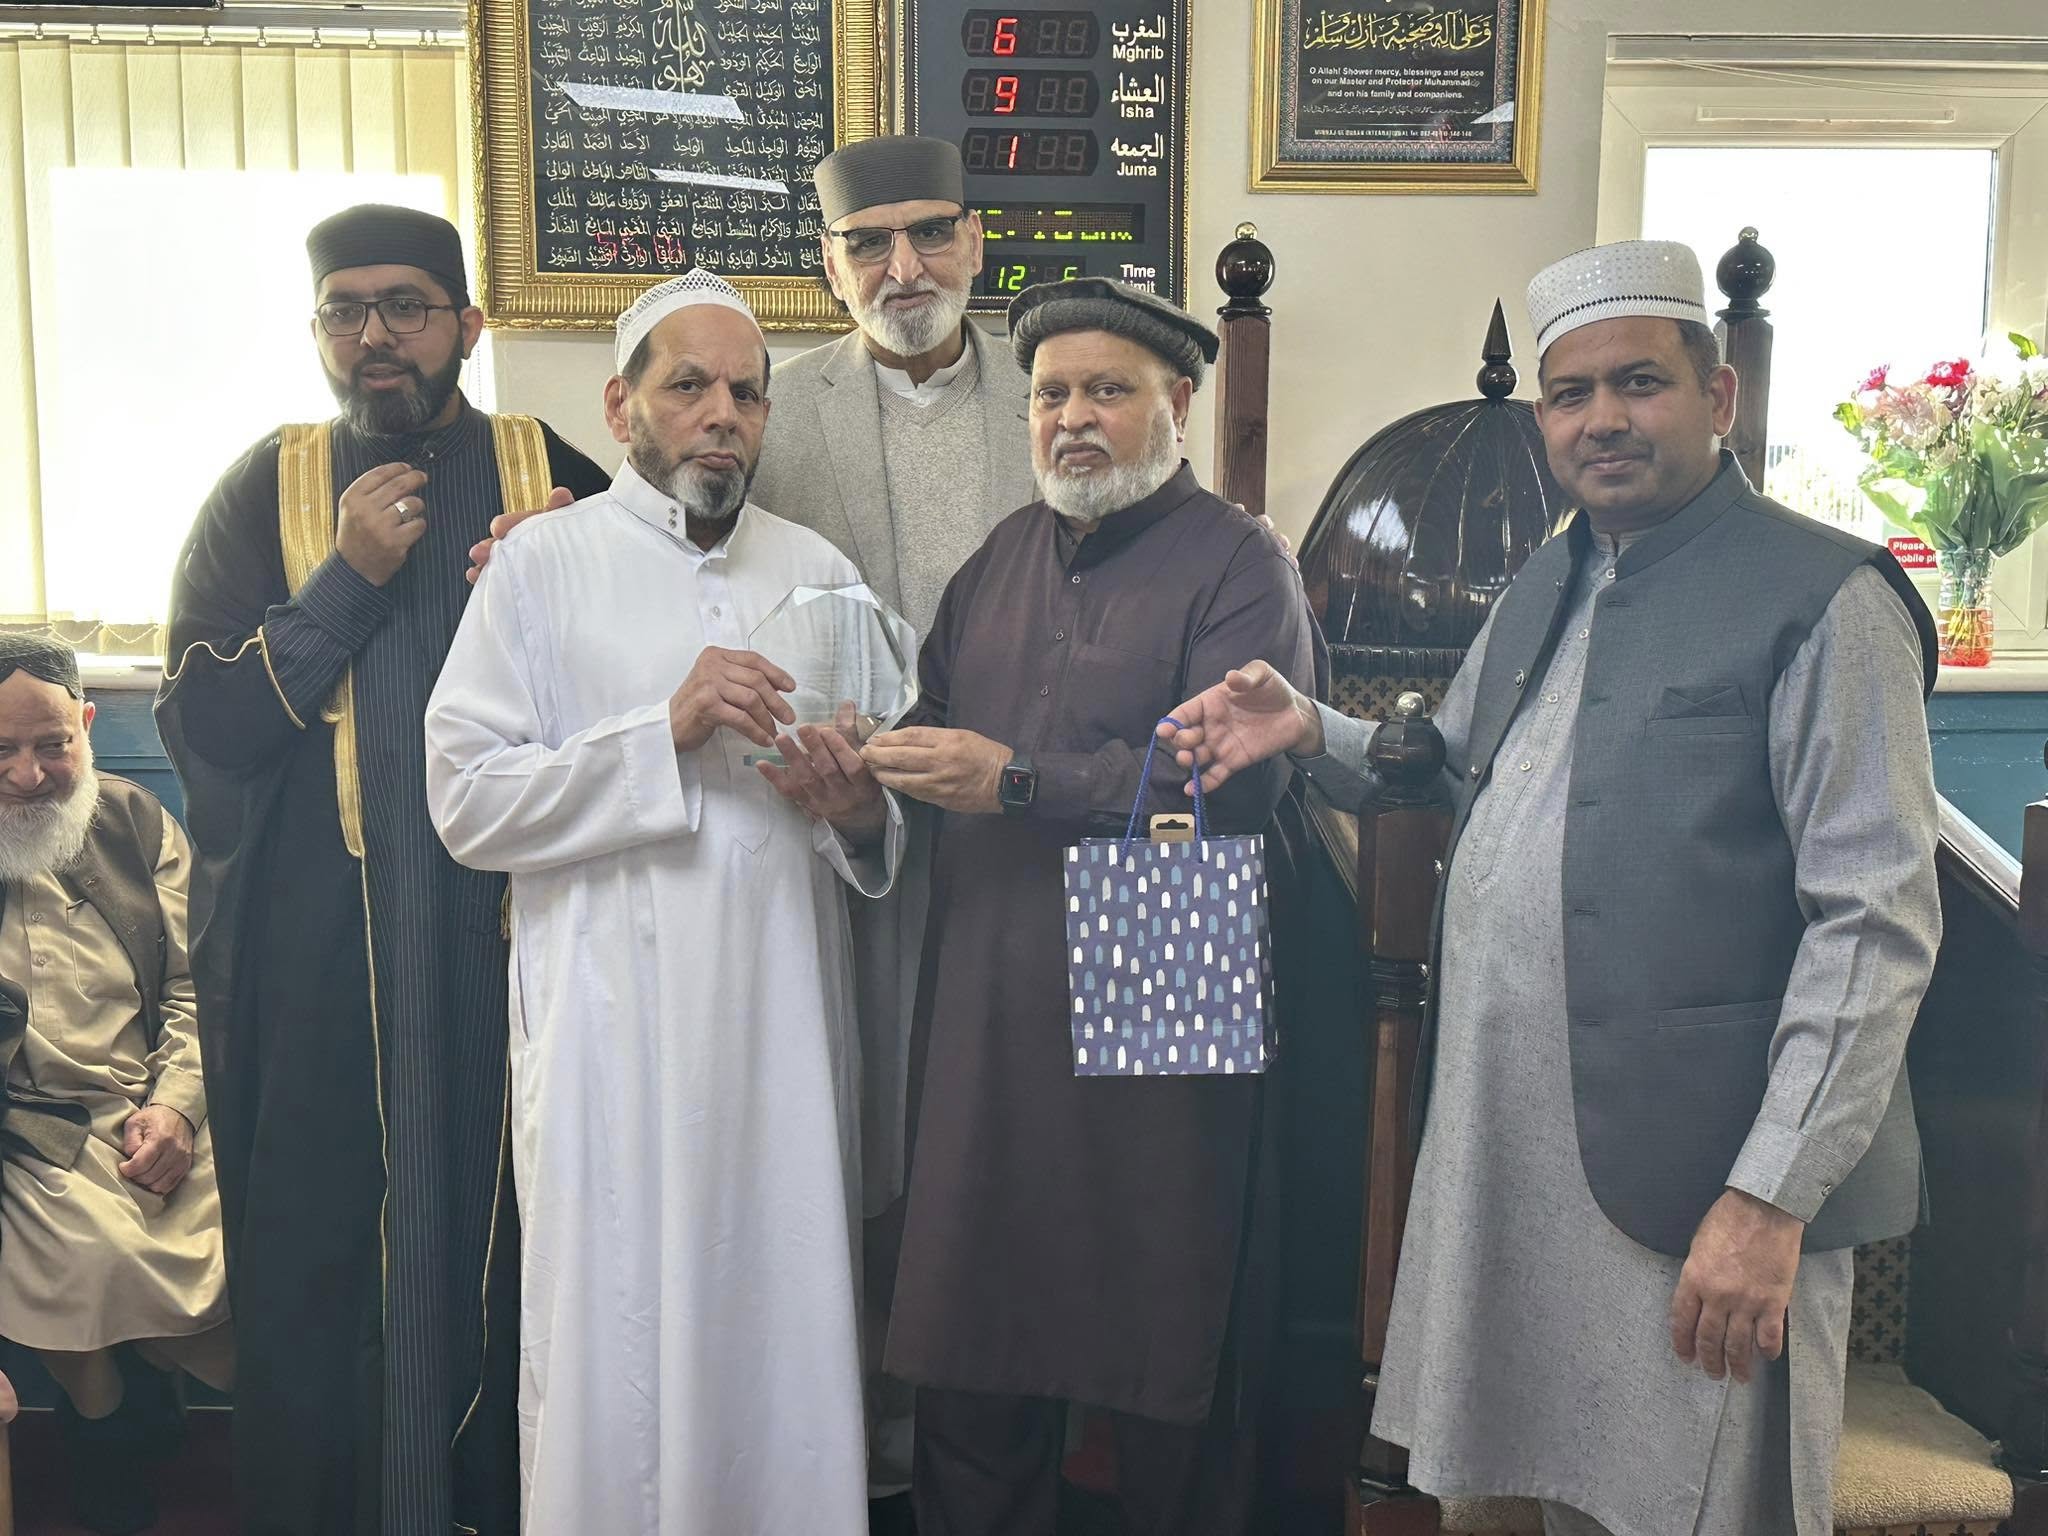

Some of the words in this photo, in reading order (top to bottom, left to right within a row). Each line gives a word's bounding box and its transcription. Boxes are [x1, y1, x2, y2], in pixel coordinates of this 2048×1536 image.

[993, 17, 1018, 55] 6
[1112, 14, 1166, 46] المغرب
[1113, 44, 1164, 62] Mghrib
[1309, 67, 1317, 75] O
[1318, 67, 1341, 75] Allah!
[1342, 67, 1374, 76] Shower
[1375, 69, 1401, 77] mercy,
[1403, 68, 1442, 78] blessings
[1460, 70, 1485, 78] peace
[1111, 72, 1165, 105] العشاء
[1339, 77, 1366, 86] Master
[1385, 78, 1422, 86] Protector
[1424, 78, 1471, 86] Muhammad
[994, 76, 1019, 113] 9
[1370, 90, 1395, 99] family
[1396, 90, 1412, 98] and
[1414, 91, 1465, 99] companions.
[1120, 105, 1155, 118] Isha
[1008, 135, 1018, 169] 1
[1117, 162, 1157, 176] Juma
[1120, 264, 1156, 278] Time
[1892, 541, 1925, 550] Please
